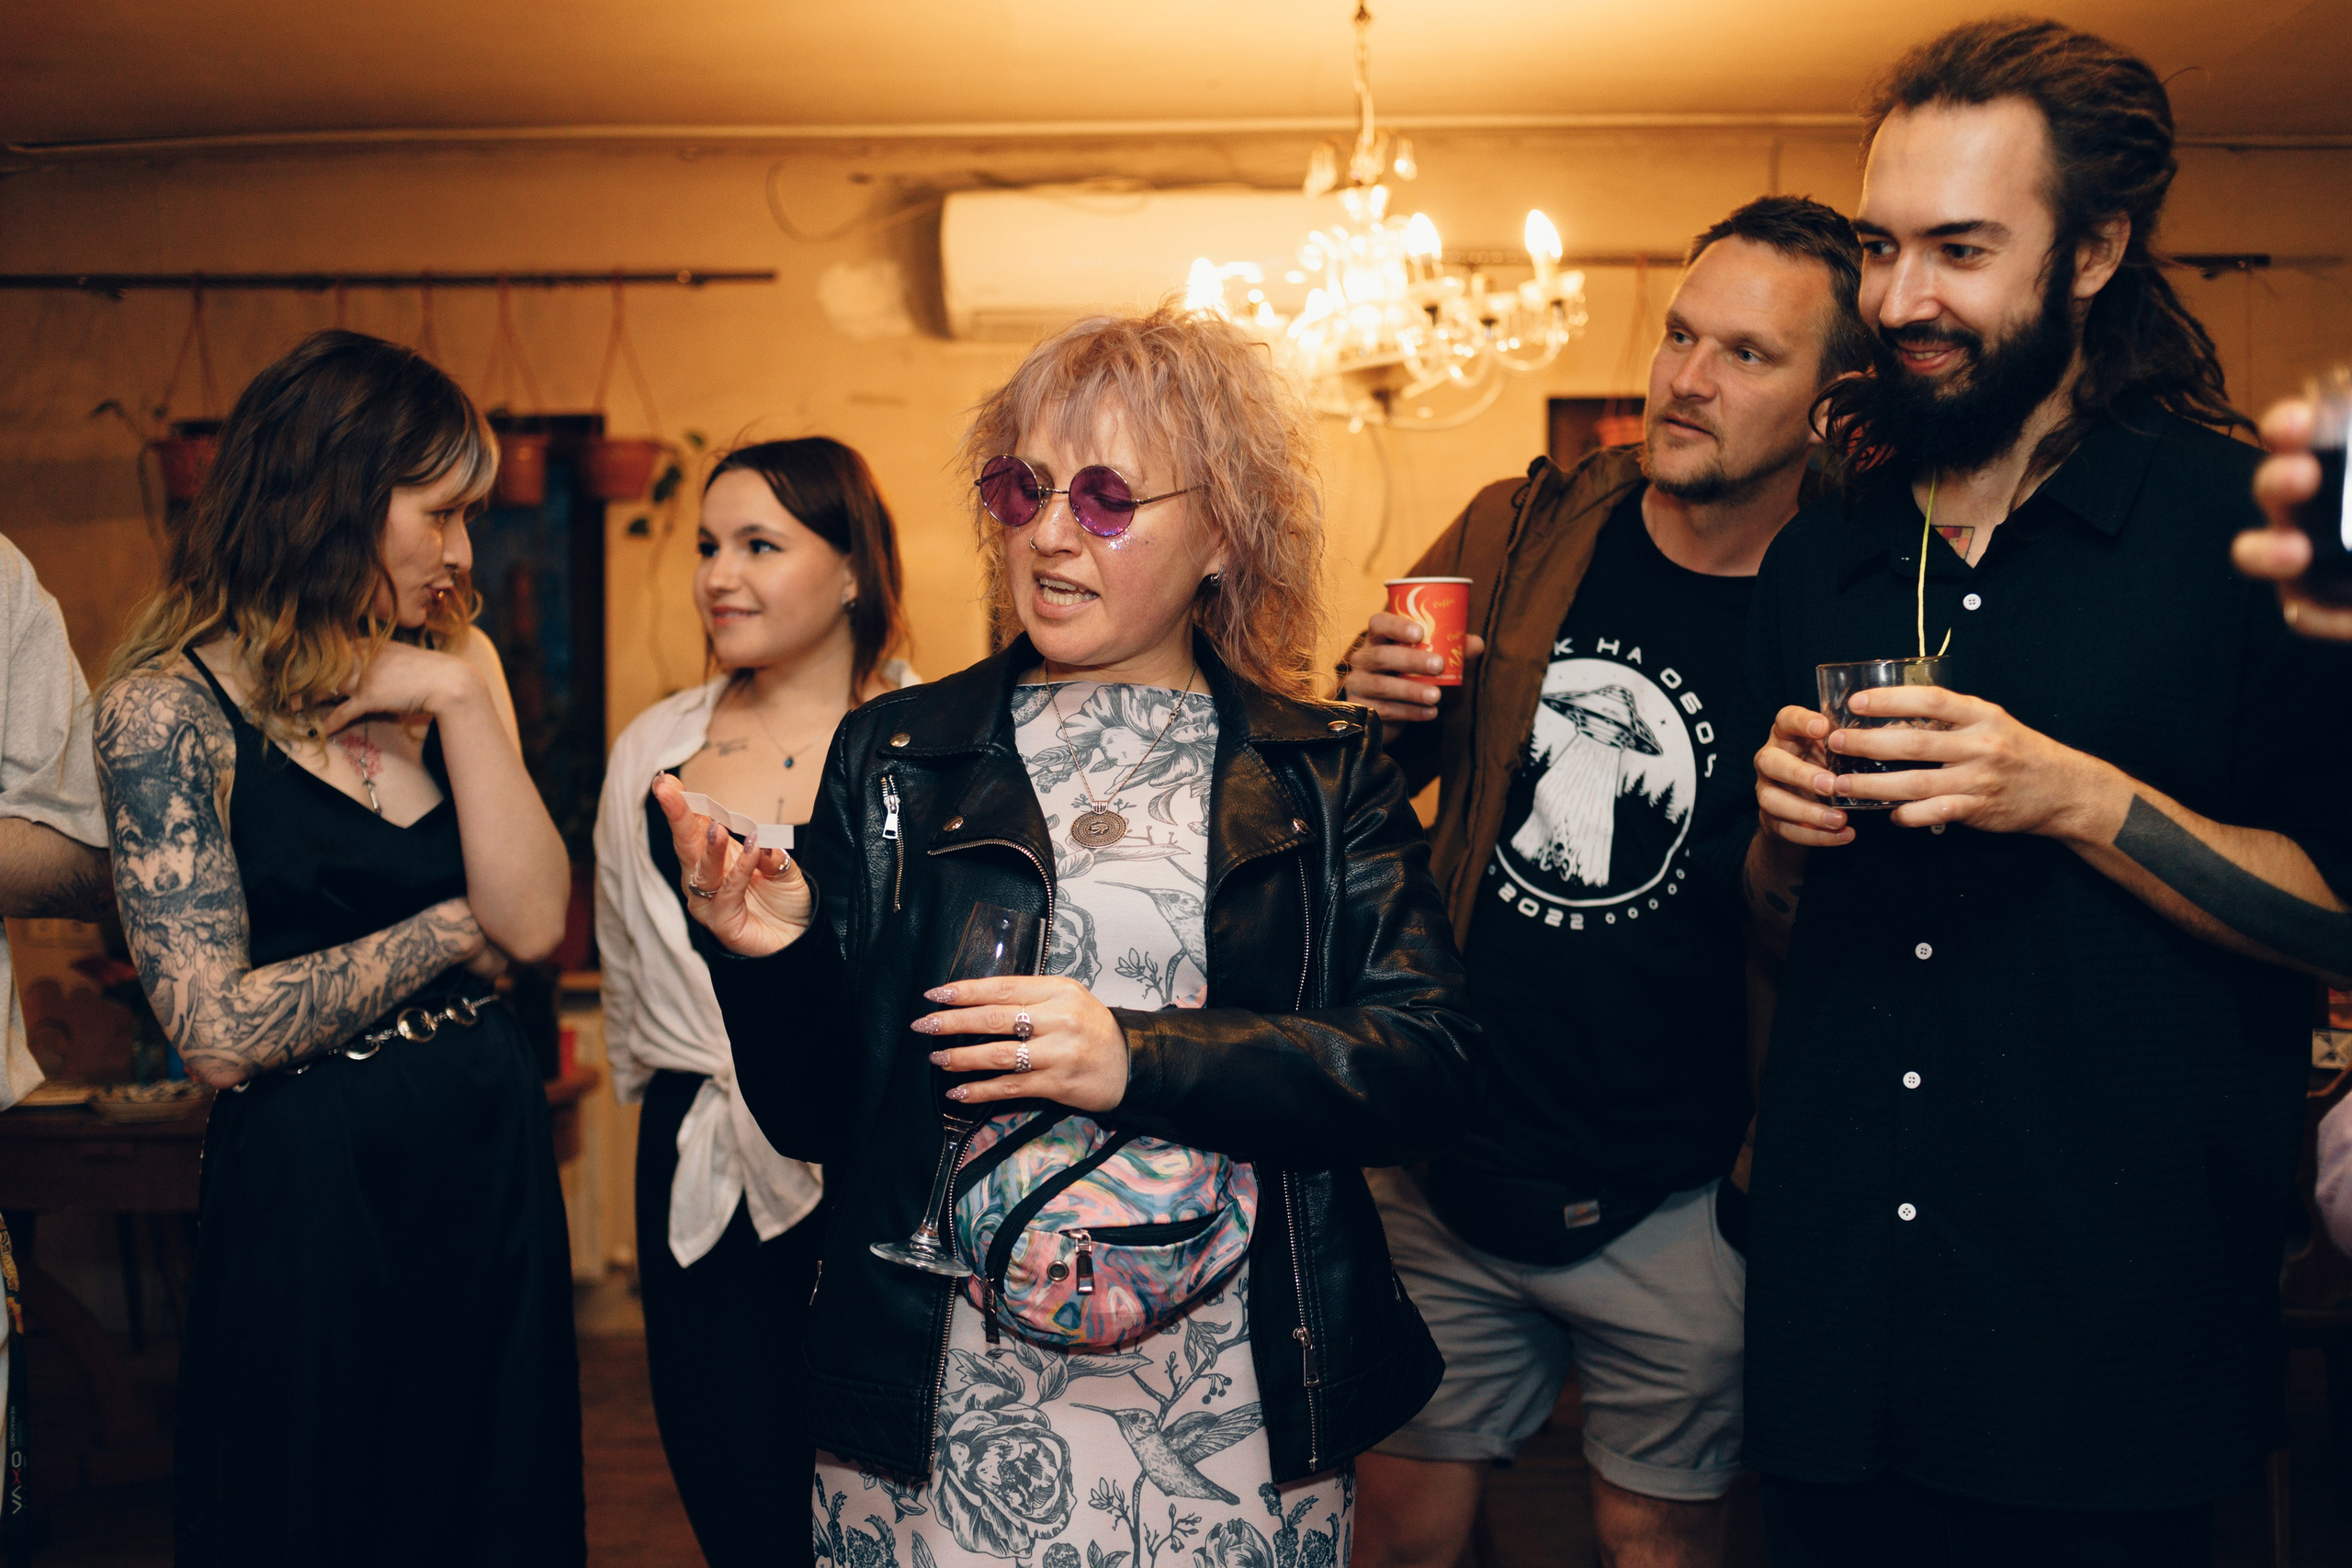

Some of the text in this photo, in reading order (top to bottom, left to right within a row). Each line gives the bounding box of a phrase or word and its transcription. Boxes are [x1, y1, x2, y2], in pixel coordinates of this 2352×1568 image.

[1596, 637, 1643, 665] НА
[1498, 881, 1585, 931] 2022
[11, 1450, 22, 1515] OXVA
